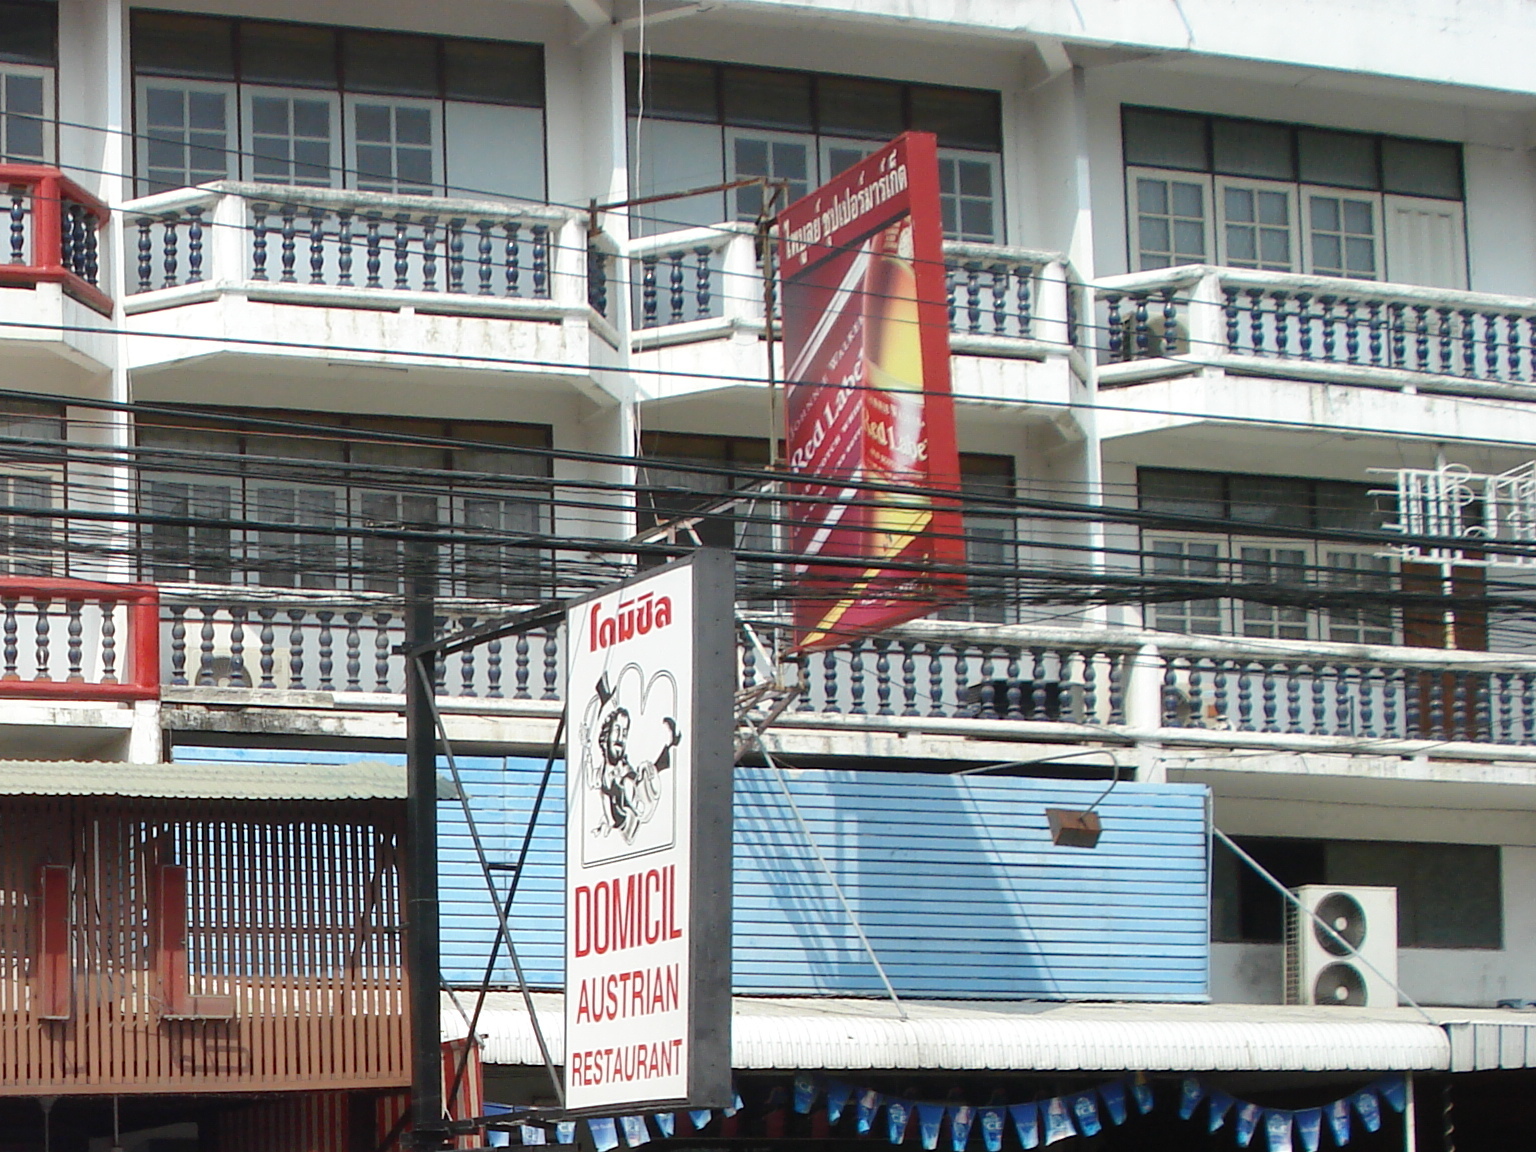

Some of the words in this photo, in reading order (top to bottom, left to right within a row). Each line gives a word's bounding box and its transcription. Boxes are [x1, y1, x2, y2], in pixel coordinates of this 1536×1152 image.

[791, 418, 826, 474] Red
[574, 864, 683, 959] DOMICIL
[576, 962, 680, 1025] AUSTRIAN
[571, 1038, 683, 1088] RESTAURANT
